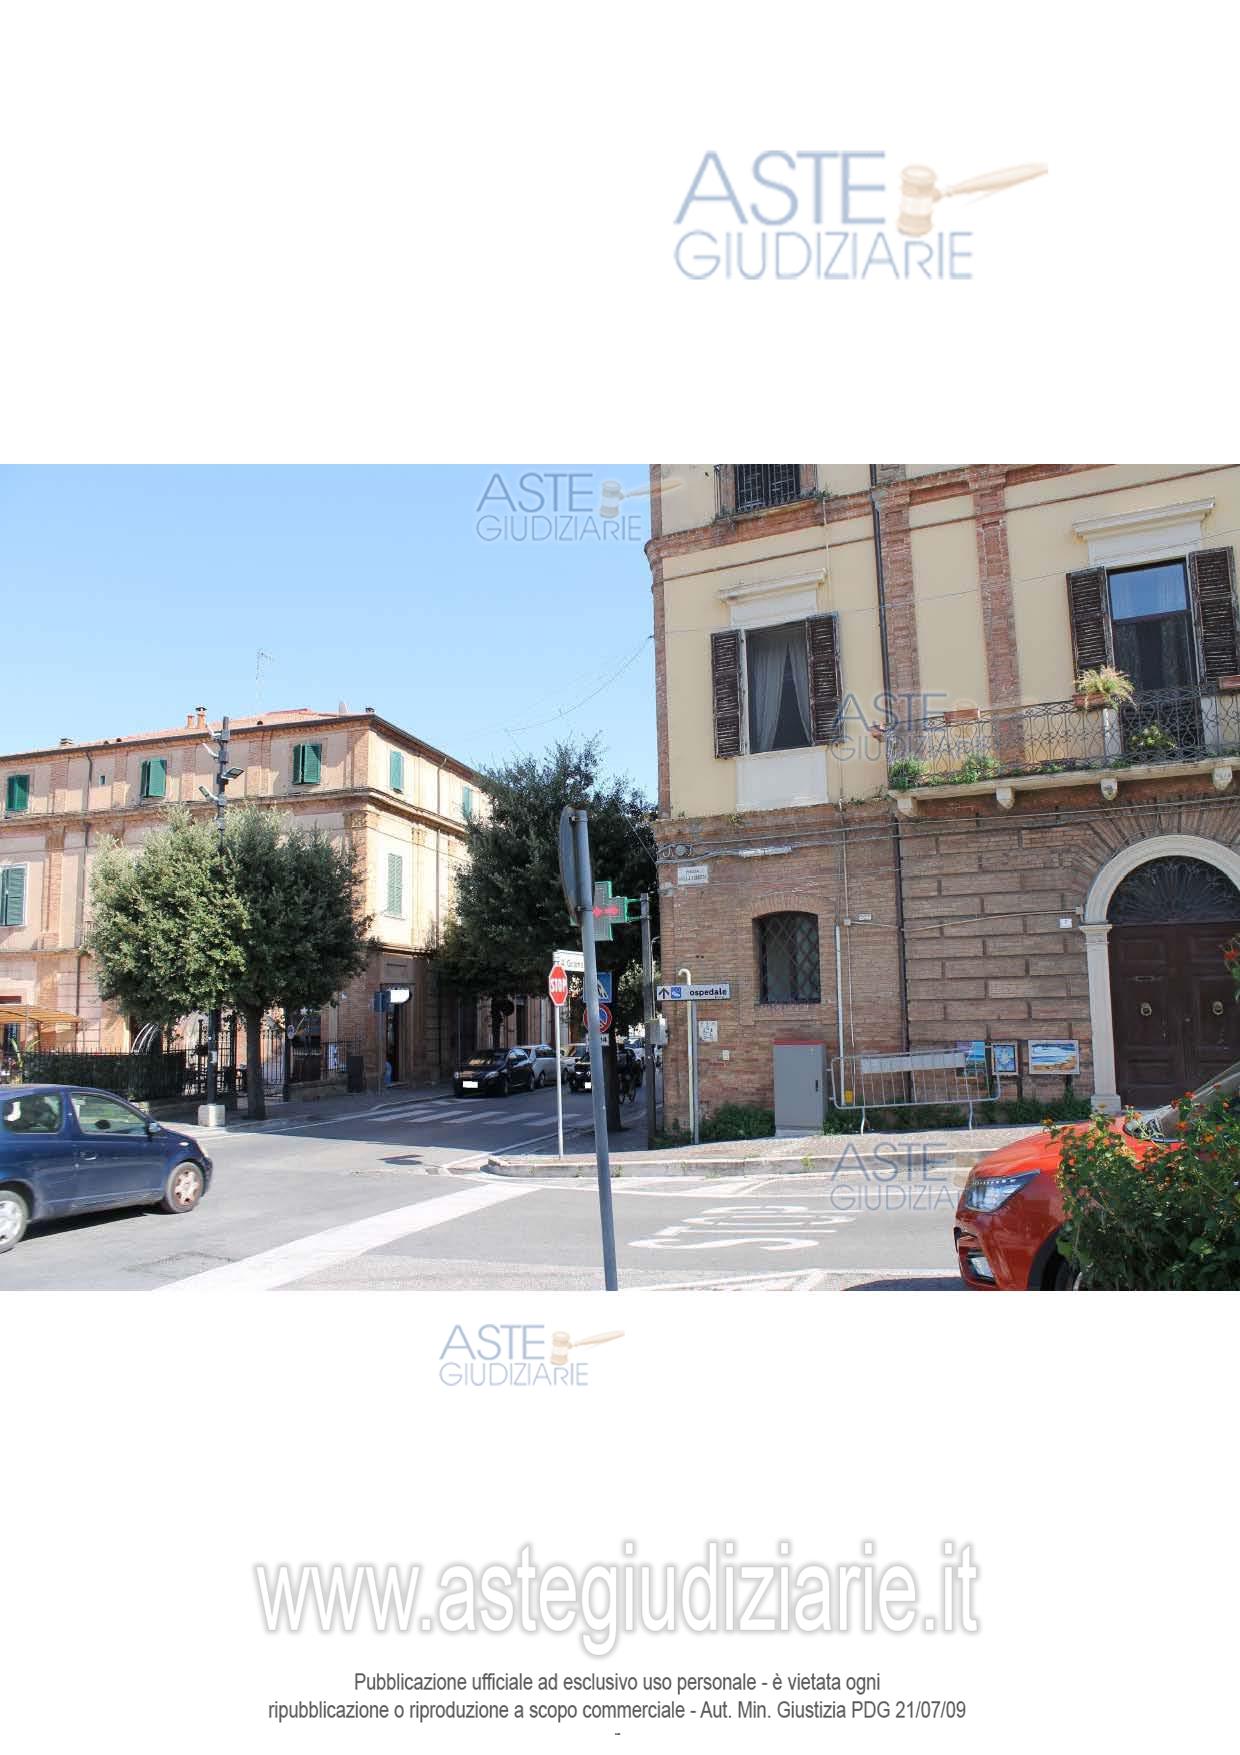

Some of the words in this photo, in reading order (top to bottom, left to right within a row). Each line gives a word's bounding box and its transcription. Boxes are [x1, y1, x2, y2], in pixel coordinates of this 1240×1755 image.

[550, 979, 567, 993] STOP
[689, 987, 727, 997] ospedale
[627, 1205, 864, 1251] STOP
